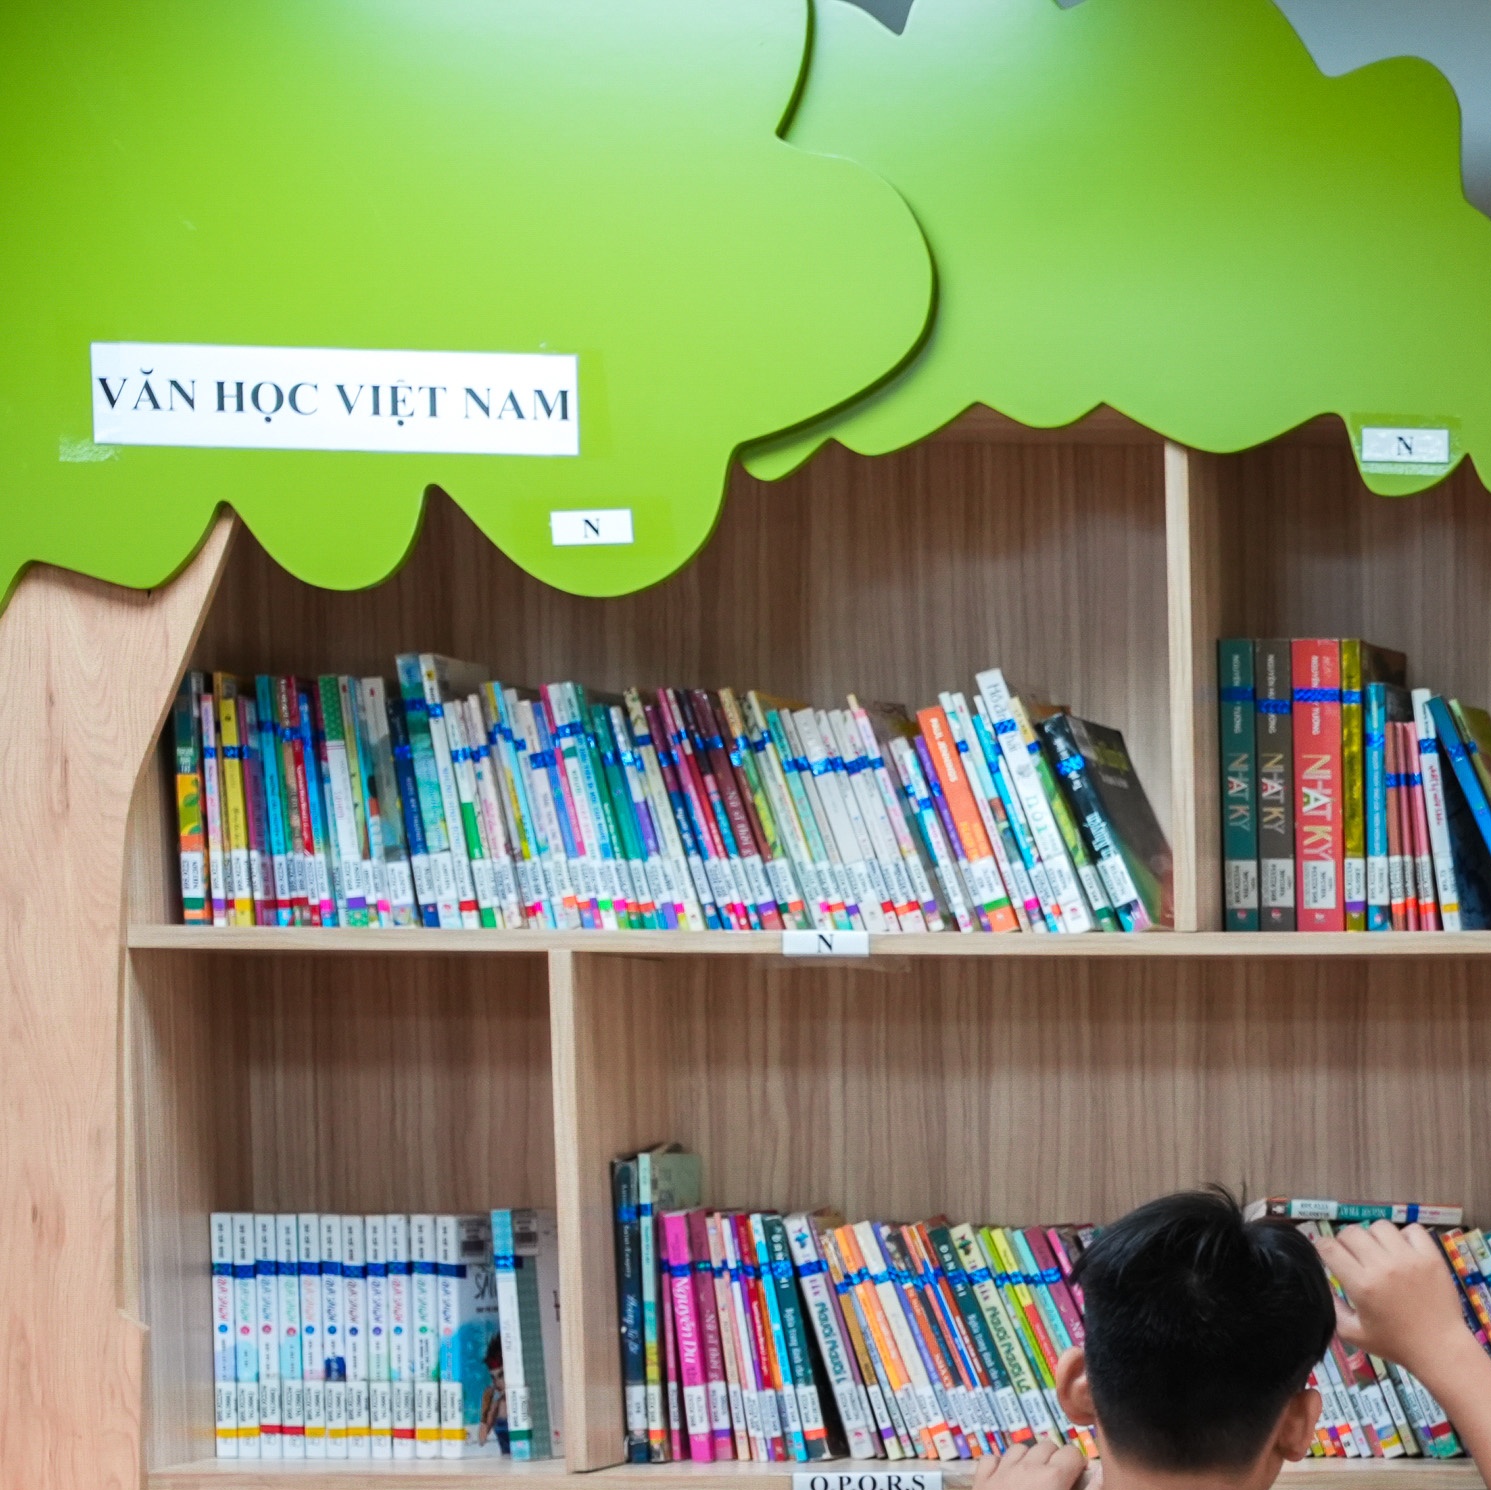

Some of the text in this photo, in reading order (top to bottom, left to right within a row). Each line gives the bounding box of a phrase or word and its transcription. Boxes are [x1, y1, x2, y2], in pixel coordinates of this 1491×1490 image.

[97, 368, 571, 428] VĂN HỌC VIỆT NAM
[1396, 435, 1414, 456] N
[583, 518, 601, 538] N
[817, 934, 834, 954] N
